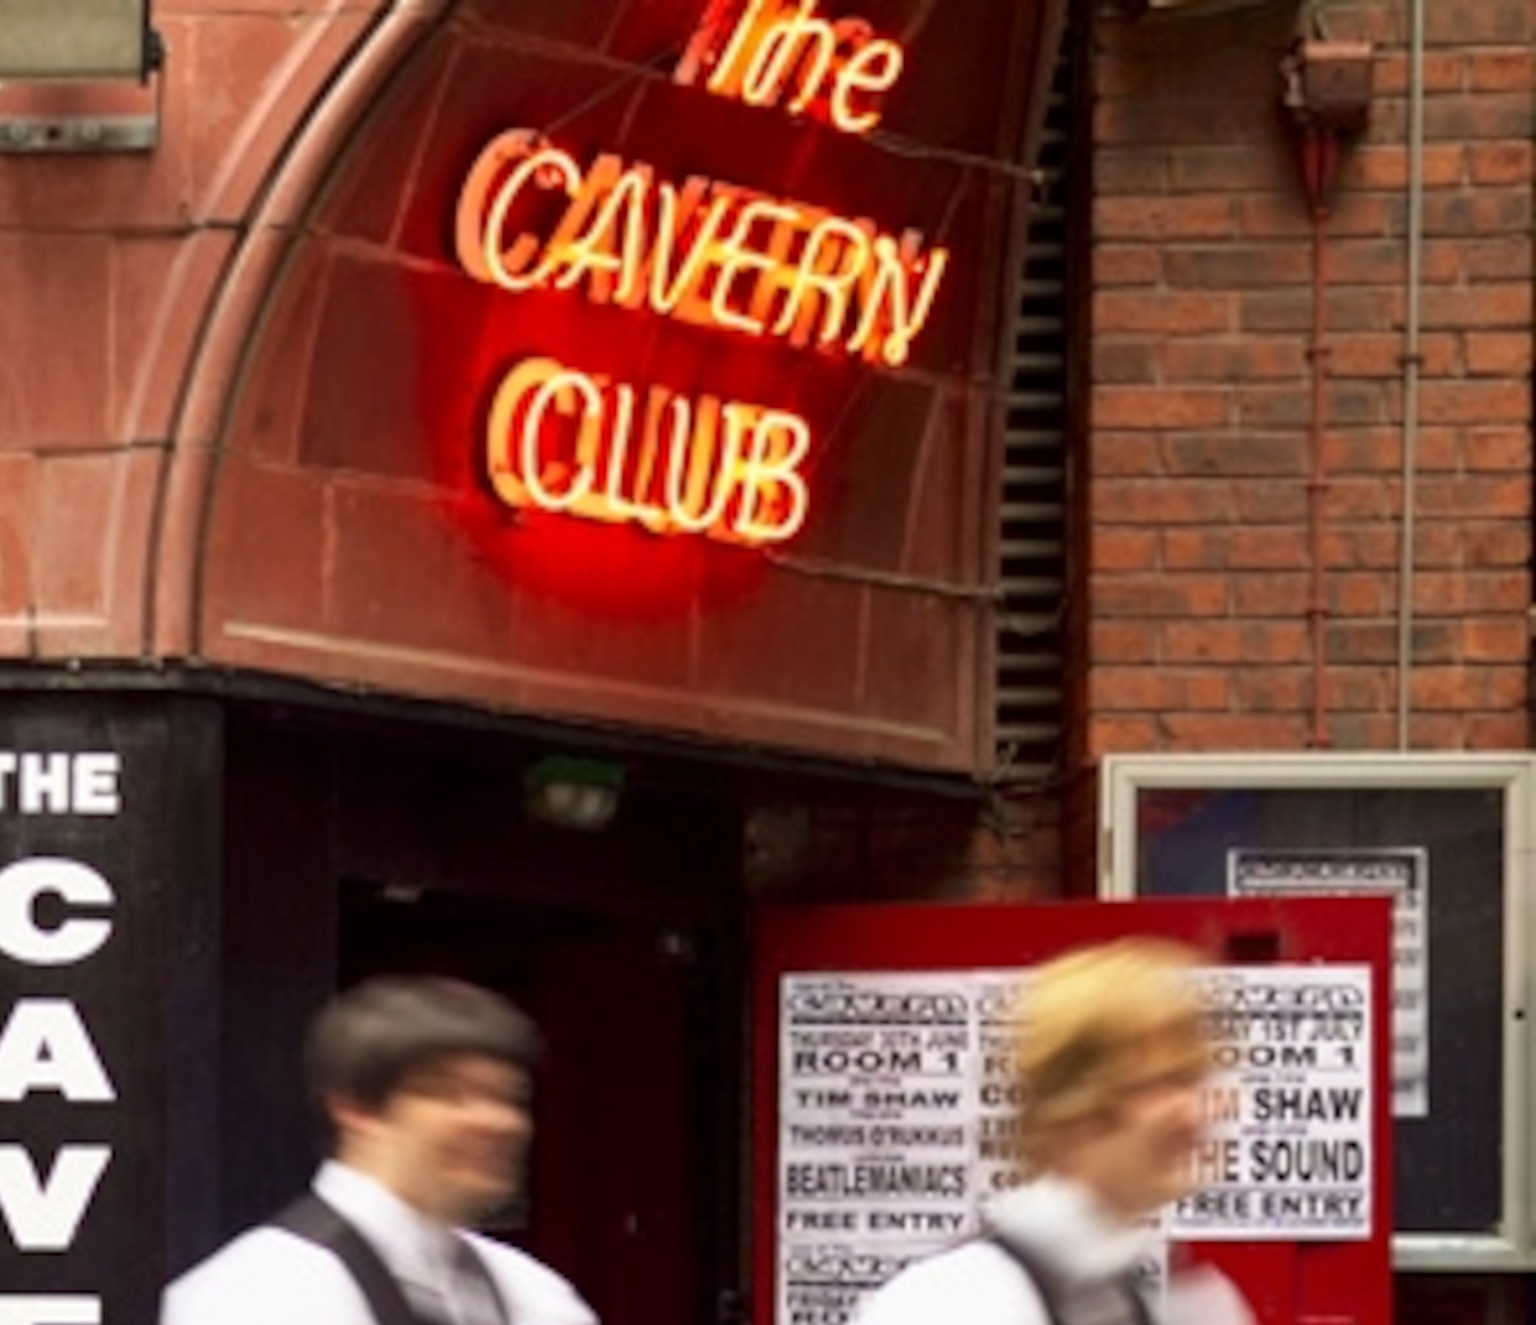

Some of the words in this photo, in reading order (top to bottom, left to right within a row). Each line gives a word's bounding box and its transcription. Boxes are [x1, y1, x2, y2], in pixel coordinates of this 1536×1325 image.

[686, 0, 904, 132] The
[467, 138, 948, 365] CAVERN
[494, 360, 809, 542] CLUB
[1310, 1019, 1363, 1042] JULY
[795, 1052, 922, 1073] ROOM
[942, 1052, 958, 1073] 1
[1213, 1046, 1317, 1067] OOM
[1336, 1046, 1354, 1067] 1
[796, 1090, 851, 1108] TIM
[864, 1090, 961, 1109] SHAW
[1254, 1087, 1364, 1122] SHAW
[1250, 1139, 1364, 1182] SOUND
[787, 1164, 967, 1198] BEATLEMANIACS
[1176, 1191, 1249, 1219] FREE
[1261, 1191, 1362, 1219] ENTRY
[787, 1211, 857, 1231] FREE
[869, 1211, 965, 1232] ENTRY
